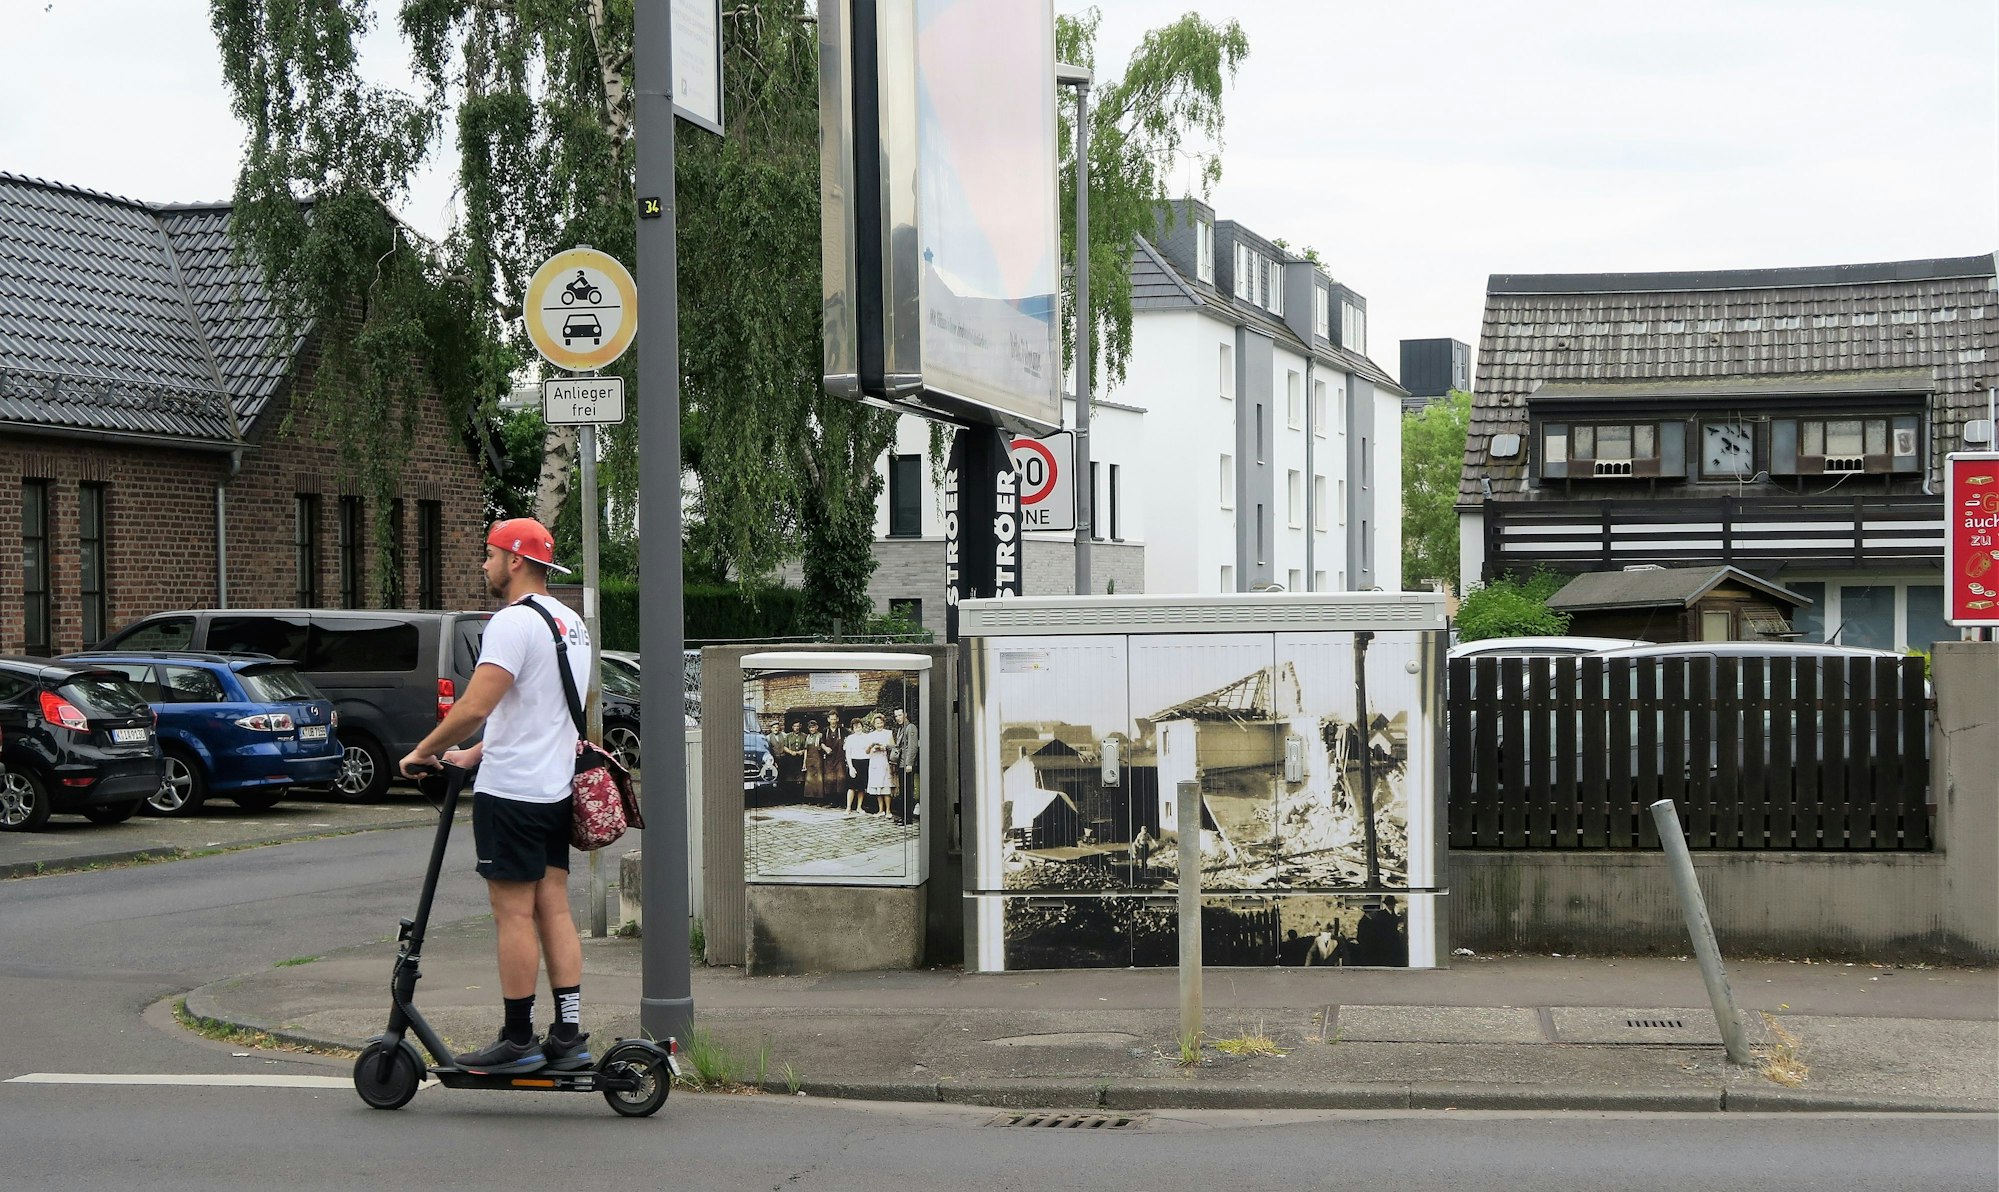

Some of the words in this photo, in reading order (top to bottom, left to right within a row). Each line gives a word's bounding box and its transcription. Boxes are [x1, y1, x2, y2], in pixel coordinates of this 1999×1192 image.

[645, 199, 660, 214] 34
[553, 386, 614, 402] Anlieger
[572, 403, 597, 416] frei
[1021, 508, 1050, 525] NE
[1964, 513, 1999, 528] auch
[1970, 534, 1992, 546] zu
